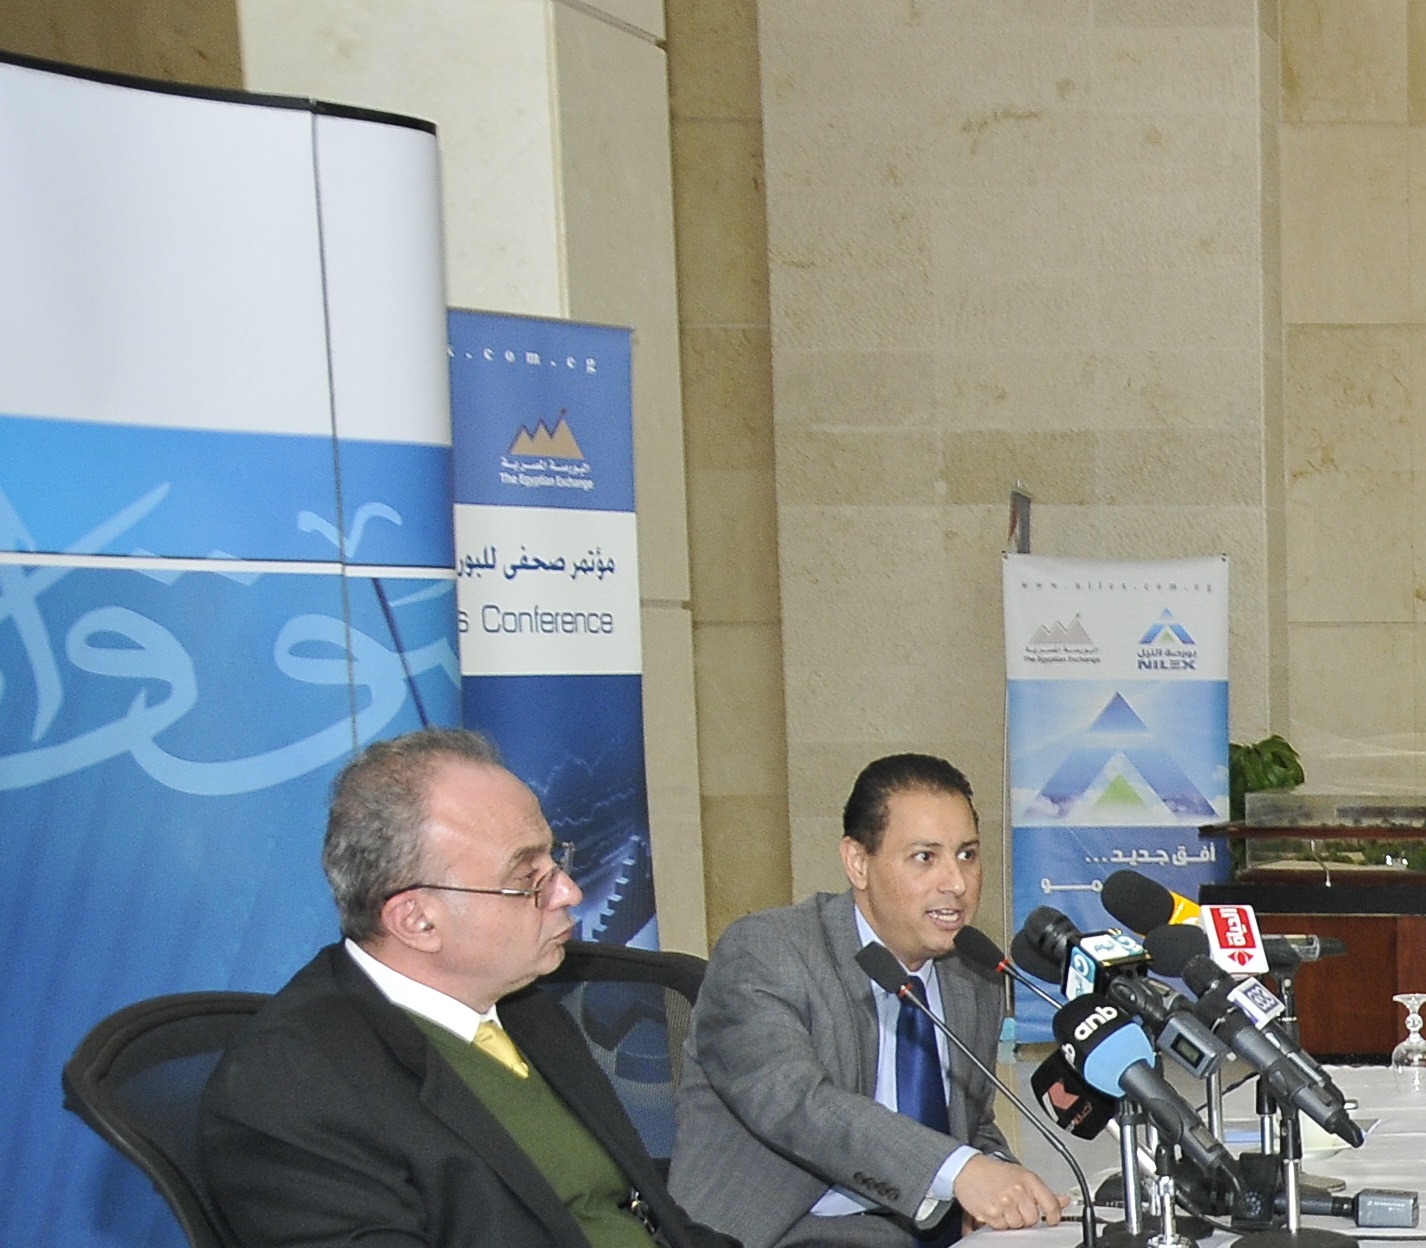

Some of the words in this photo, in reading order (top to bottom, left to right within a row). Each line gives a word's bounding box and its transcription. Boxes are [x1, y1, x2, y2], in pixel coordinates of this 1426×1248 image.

[499, 471, 518, 484] The
[518, 473, 555, 488] Egyptian
[555, 475, 595, 492] Exchange
[570, 547, 616, 580] مؤتمر
[481, 604, 614, 634] Conference
[1137, 659, 1196, 670] NILEX
[1171, 842, 1216, 866] أفق
[1074, 1005, 1119, 1041] anb
